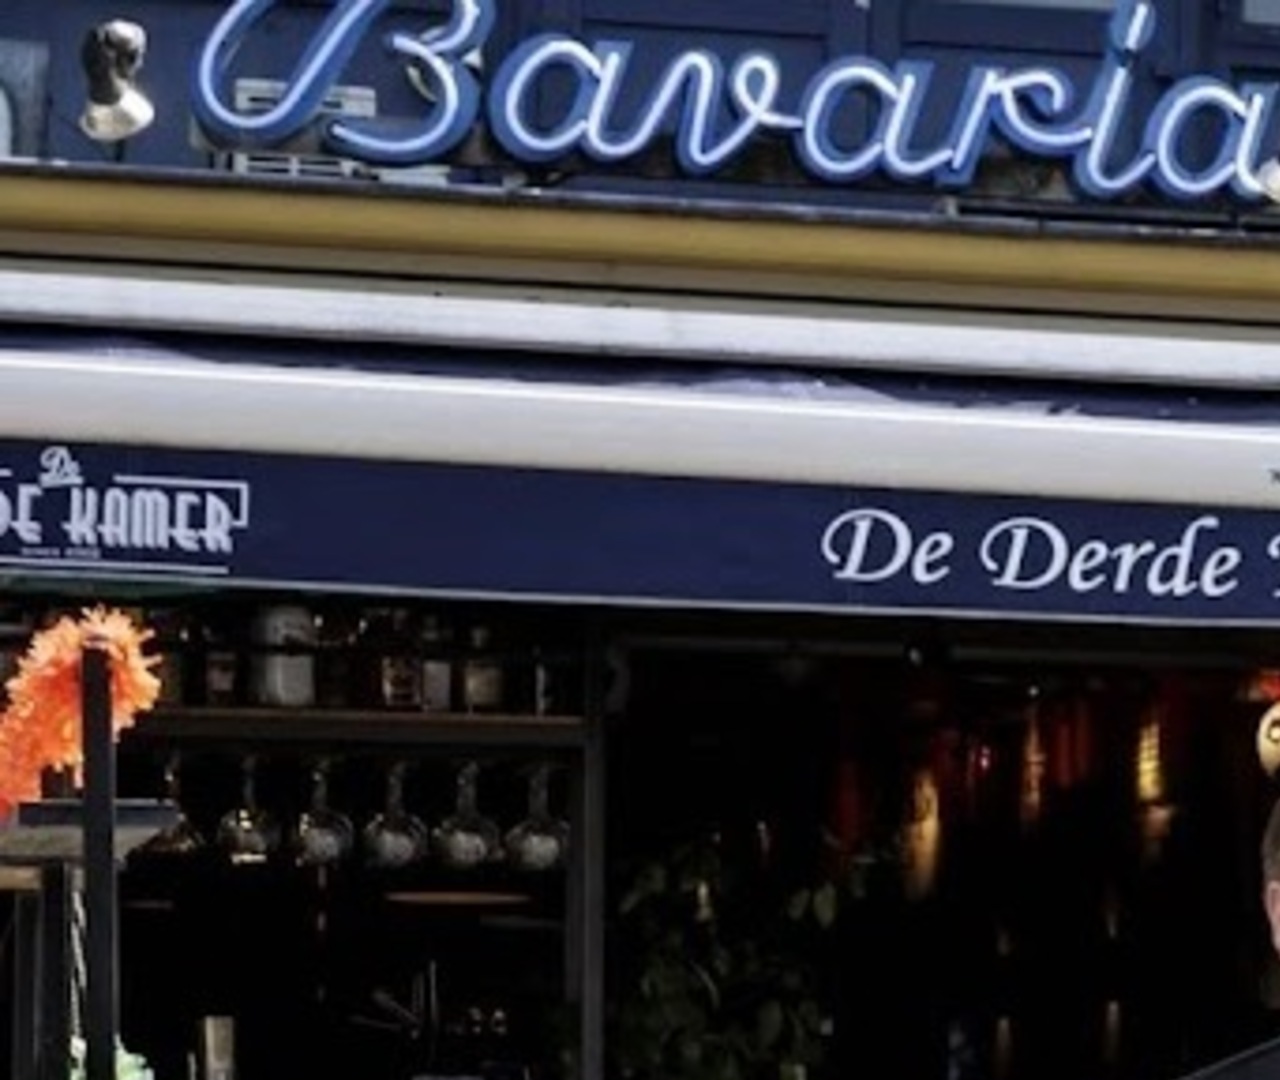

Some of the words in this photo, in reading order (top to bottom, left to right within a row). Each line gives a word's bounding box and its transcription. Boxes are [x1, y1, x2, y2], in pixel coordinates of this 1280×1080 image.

[195, 0, 1280, 198] Bavaria
[62, 486, 233, 554] KAMER
[821, 508, 953, 584] De
[979, 516, 1241, 598] Derde
